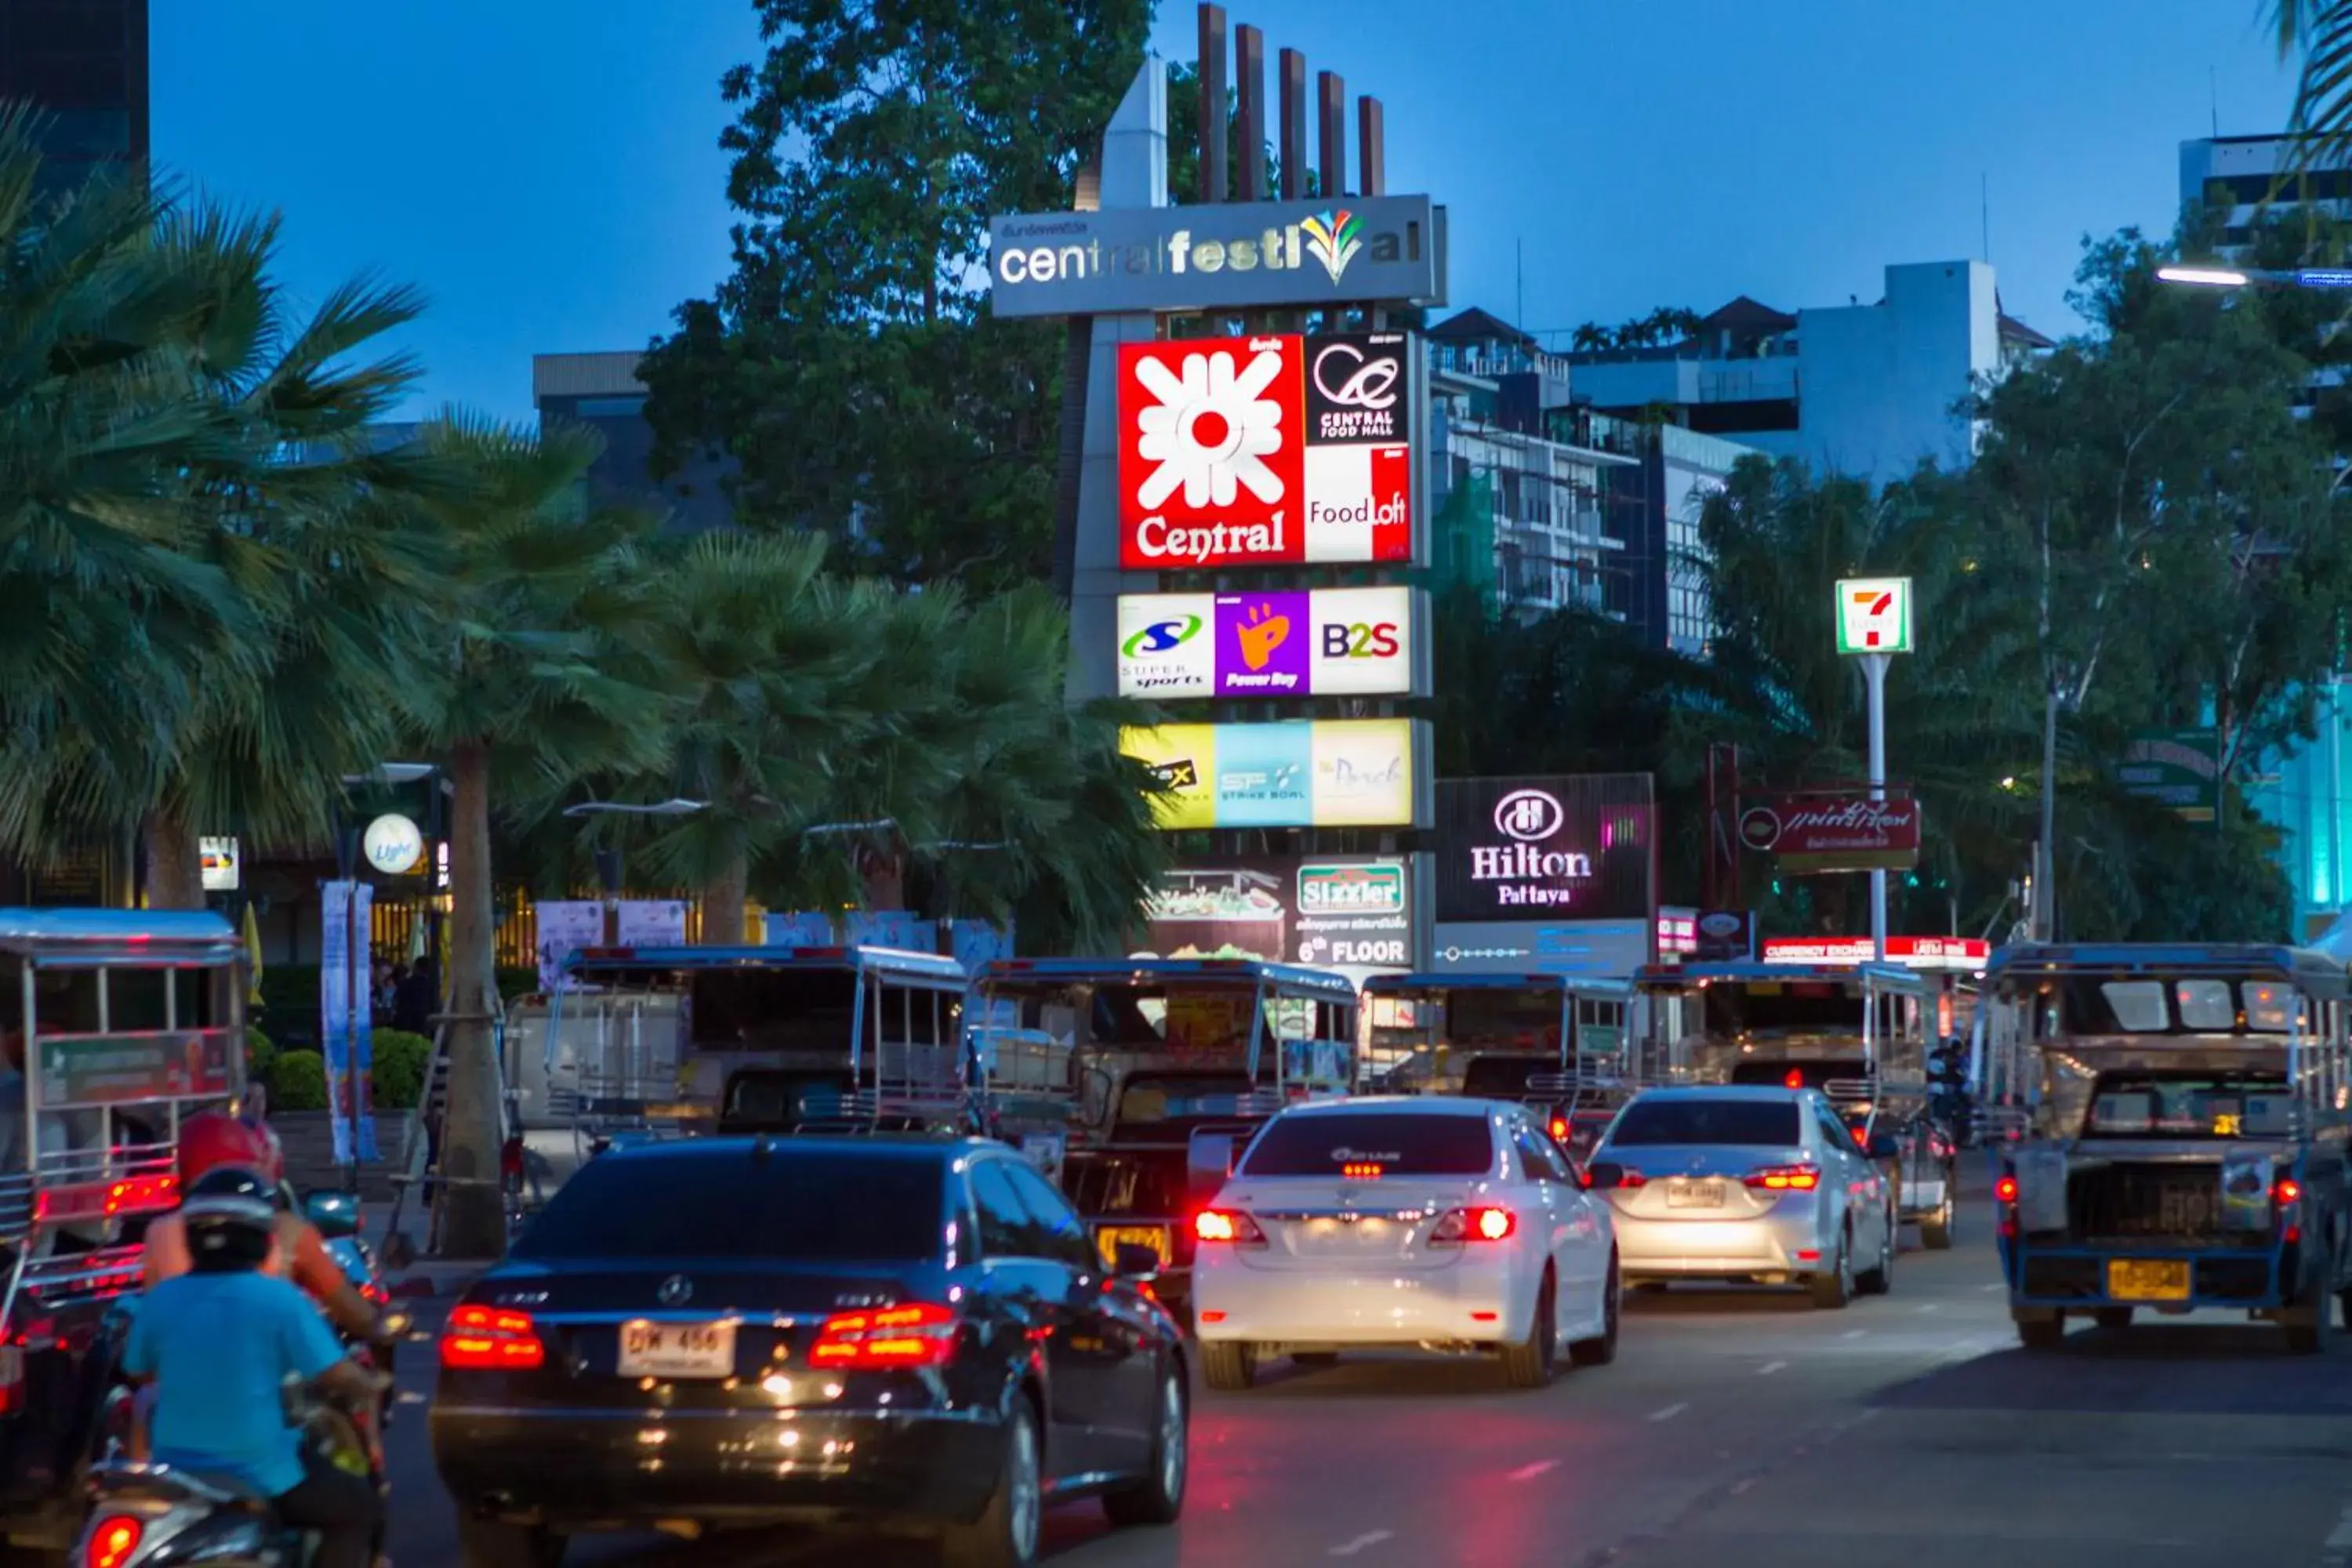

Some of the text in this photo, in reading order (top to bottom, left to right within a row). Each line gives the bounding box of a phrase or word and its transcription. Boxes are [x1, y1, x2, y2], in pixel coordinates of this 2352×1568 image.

[1320, 411, 1394, 427] CENTRAL
[1321, 423, 1394, 439] FOOD HALL
[1137, 510, 1286, 564] Central
[1323, 623, 1399, 659] B2S
[1122, 664, 1187, 677] SUPER
[1136, 674, 1203, 688] sports
[1471, 842, 1592, 879] Hilton
[1498, 885, 1571, 906] Pattaya
[1332, 940, 1405, 963] FLOOR
